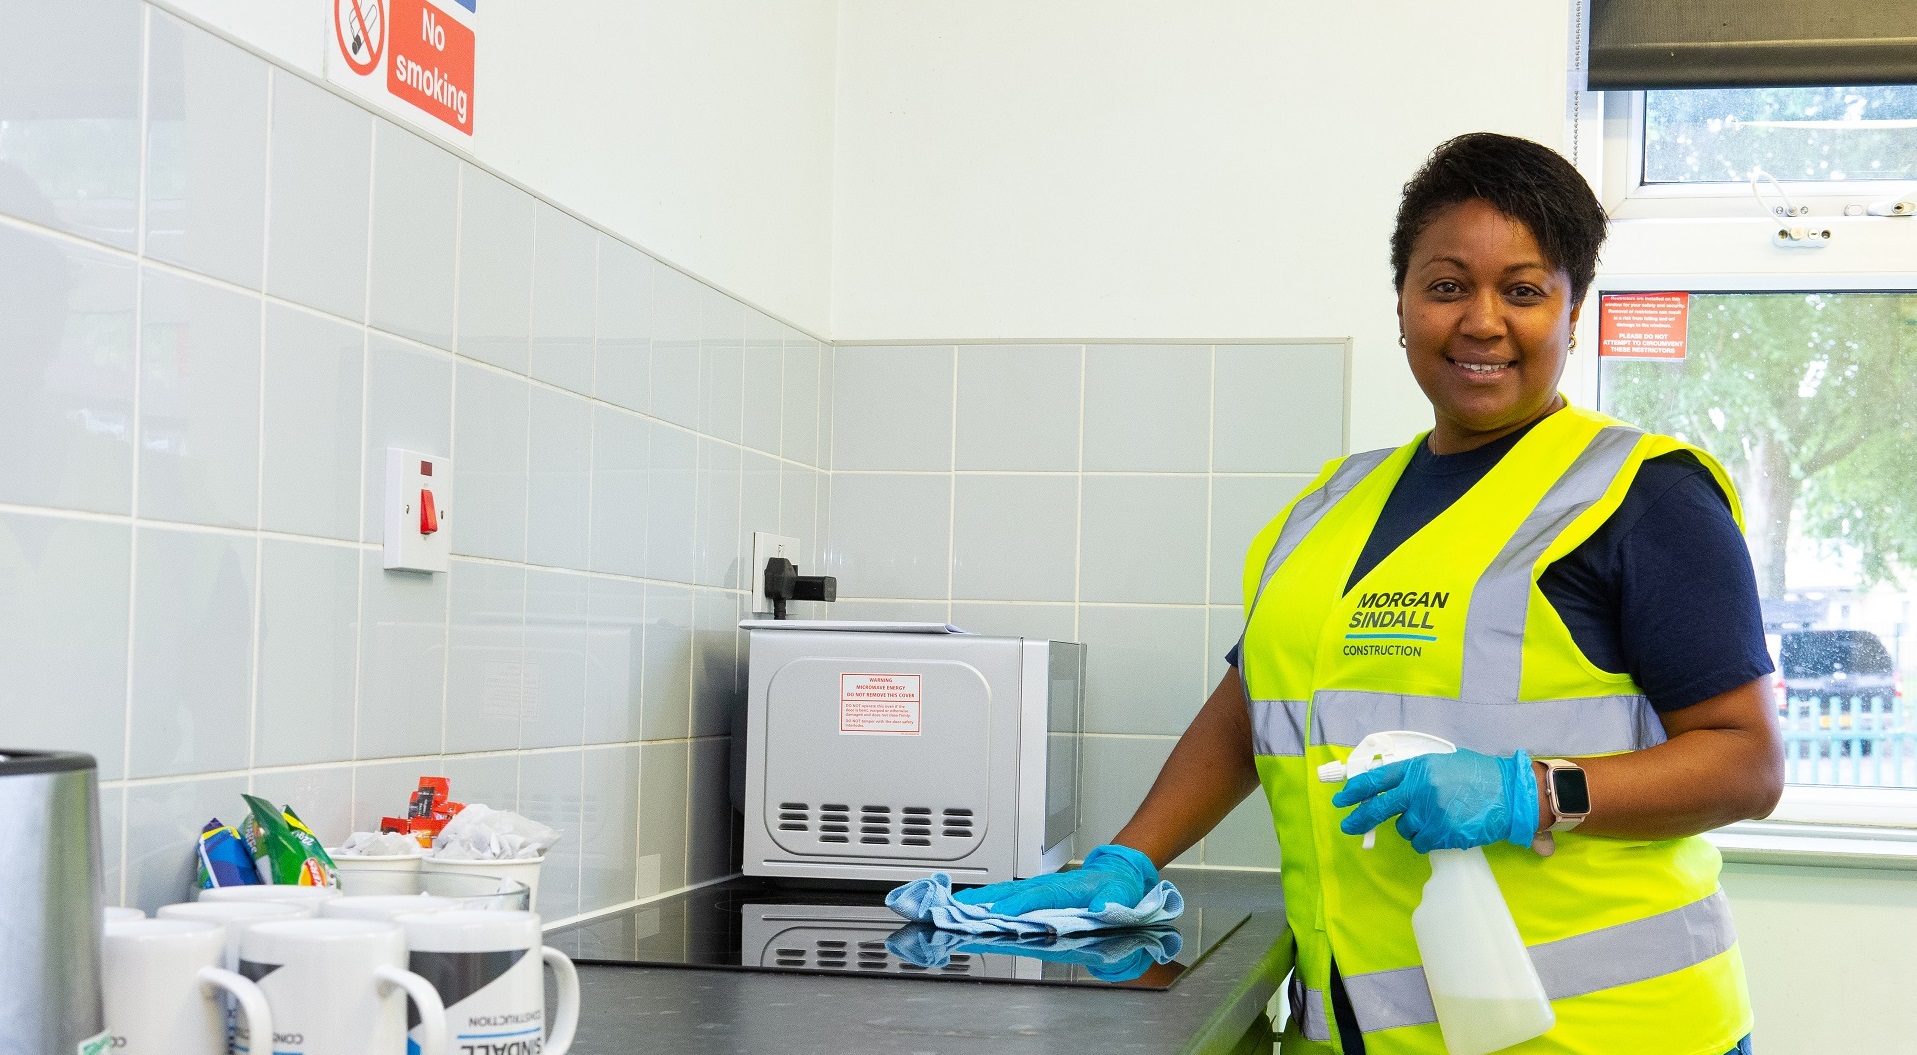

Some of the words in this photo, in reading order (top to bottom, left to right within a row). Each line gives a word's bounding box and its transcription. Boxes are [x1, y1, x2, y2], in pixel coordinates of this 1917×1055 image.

[422, 8, 446, 51] No
[396, 54, 467, 124] smoking
[1356, 592, 1450, 608] MORGAN
[1348, 610, 1434, 629] SINDALL
[1343, 645, 1422, 657] CONSTRUCTION
